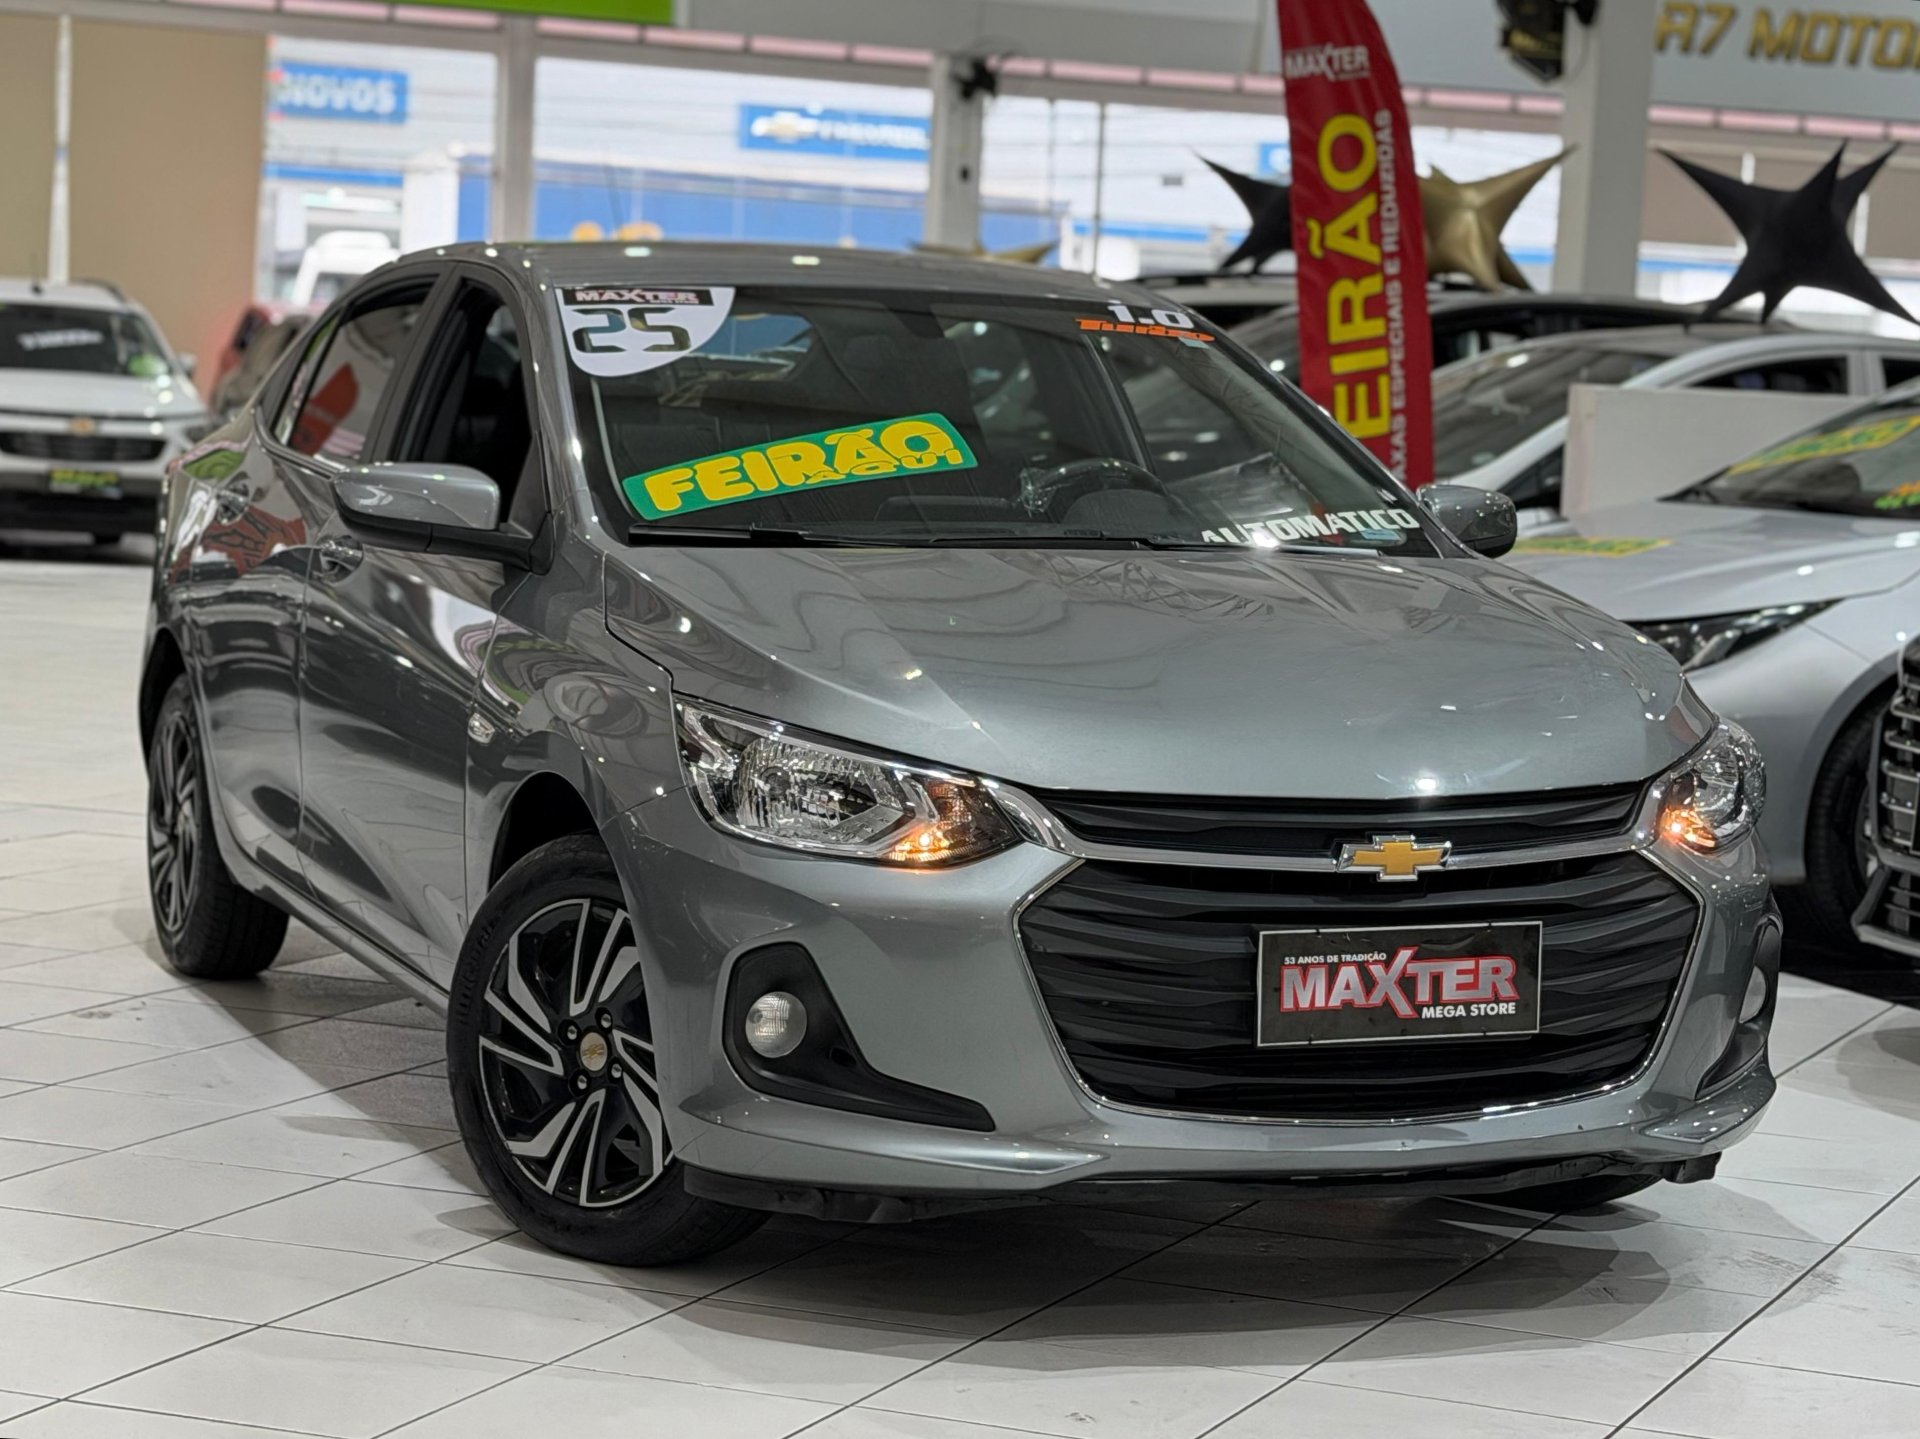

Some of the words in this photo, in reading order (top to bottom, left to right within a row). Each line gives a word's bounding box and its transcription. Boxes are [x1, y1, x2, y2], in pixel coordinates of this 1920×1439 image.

[1748, 8, 1920, 69] MOTO
[1284, 43, 1370, 82] MAXTER
[1374, 108, 1400, 253] REDUZIDAS
[1384, 258, 1401, 275] E
[575, 289, 699, 303] MAXTER
[571, 307, 692, 353] 25
[1107, 304, 1194, 329] 1.0
[643, 421, 955, 512] FEIRÃO
[1284, 956, 1296, 965] 53
[1297, 955, 1325, 964] ANOS
[1326, 954, 1339, 963] DE
[1341, 951, 1387, 963] TRADIÇÃO
[1281, 946, 1519, 1019] MAXTER
[1421, 1005, 1467, 1019] MEGA
[1470, 1002, 1516, 1017] STORE
